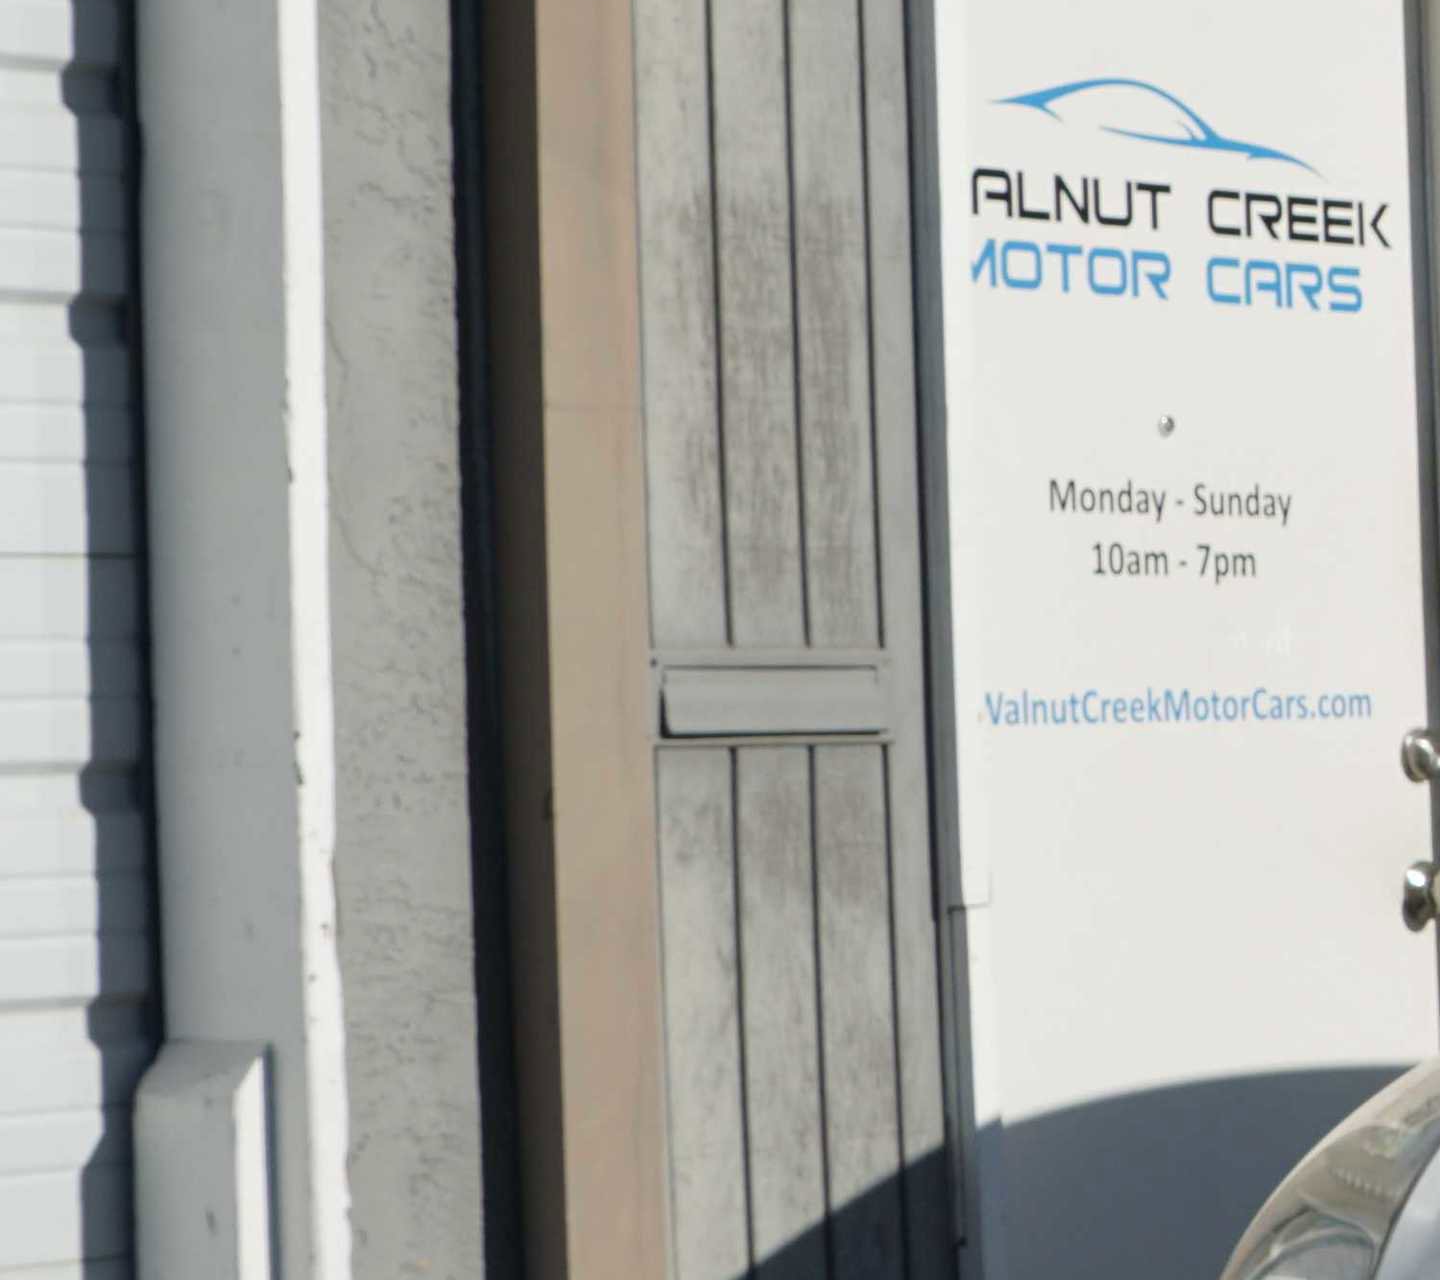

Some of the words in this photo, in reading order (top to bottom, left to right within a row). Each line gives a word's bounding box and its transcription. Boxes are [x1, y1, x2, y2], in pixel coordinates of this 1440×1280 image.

[1206, 189, 1392, 249] CREEK
[1206, 257, 1363, 313] CARS
[1048, 478, 1167, 523] Monday
[1192, 483, 1292, 525] Sunday
[1090, 543, 1170, 578] 10am
[1196, 544, 1258, 586] 7pm
